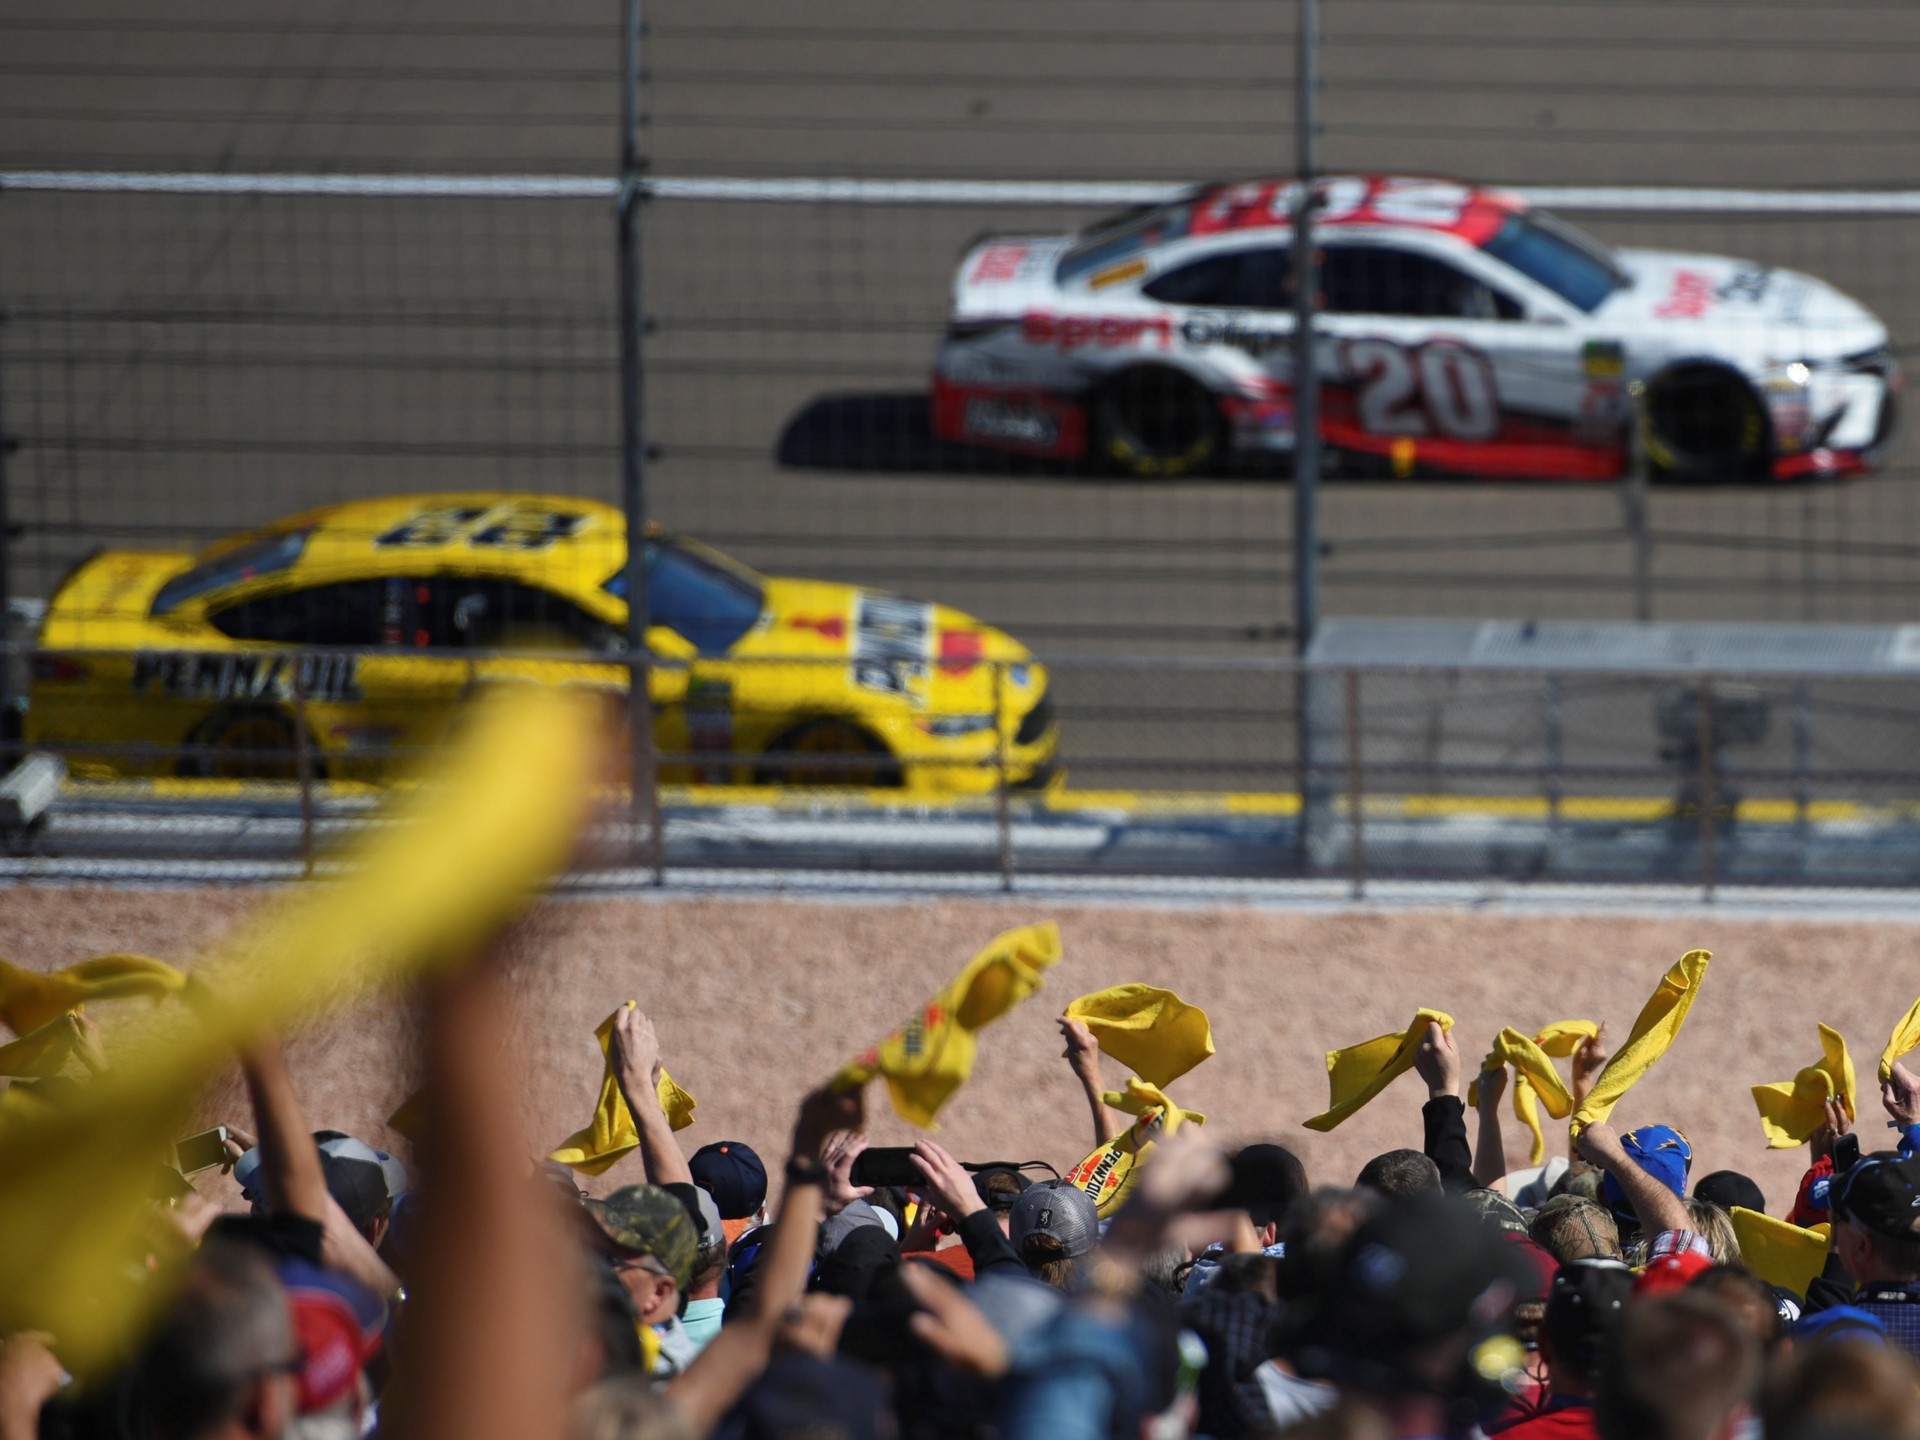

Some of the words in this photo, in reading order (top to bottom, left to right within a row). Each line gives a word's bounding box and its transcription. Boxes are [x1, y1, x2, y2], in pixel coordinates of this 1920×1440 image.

[1020, 305, 1174, 353] Sport
[1342, 338, 1497, 438] 20
[1812, 1180, 1830, 1199] 48
